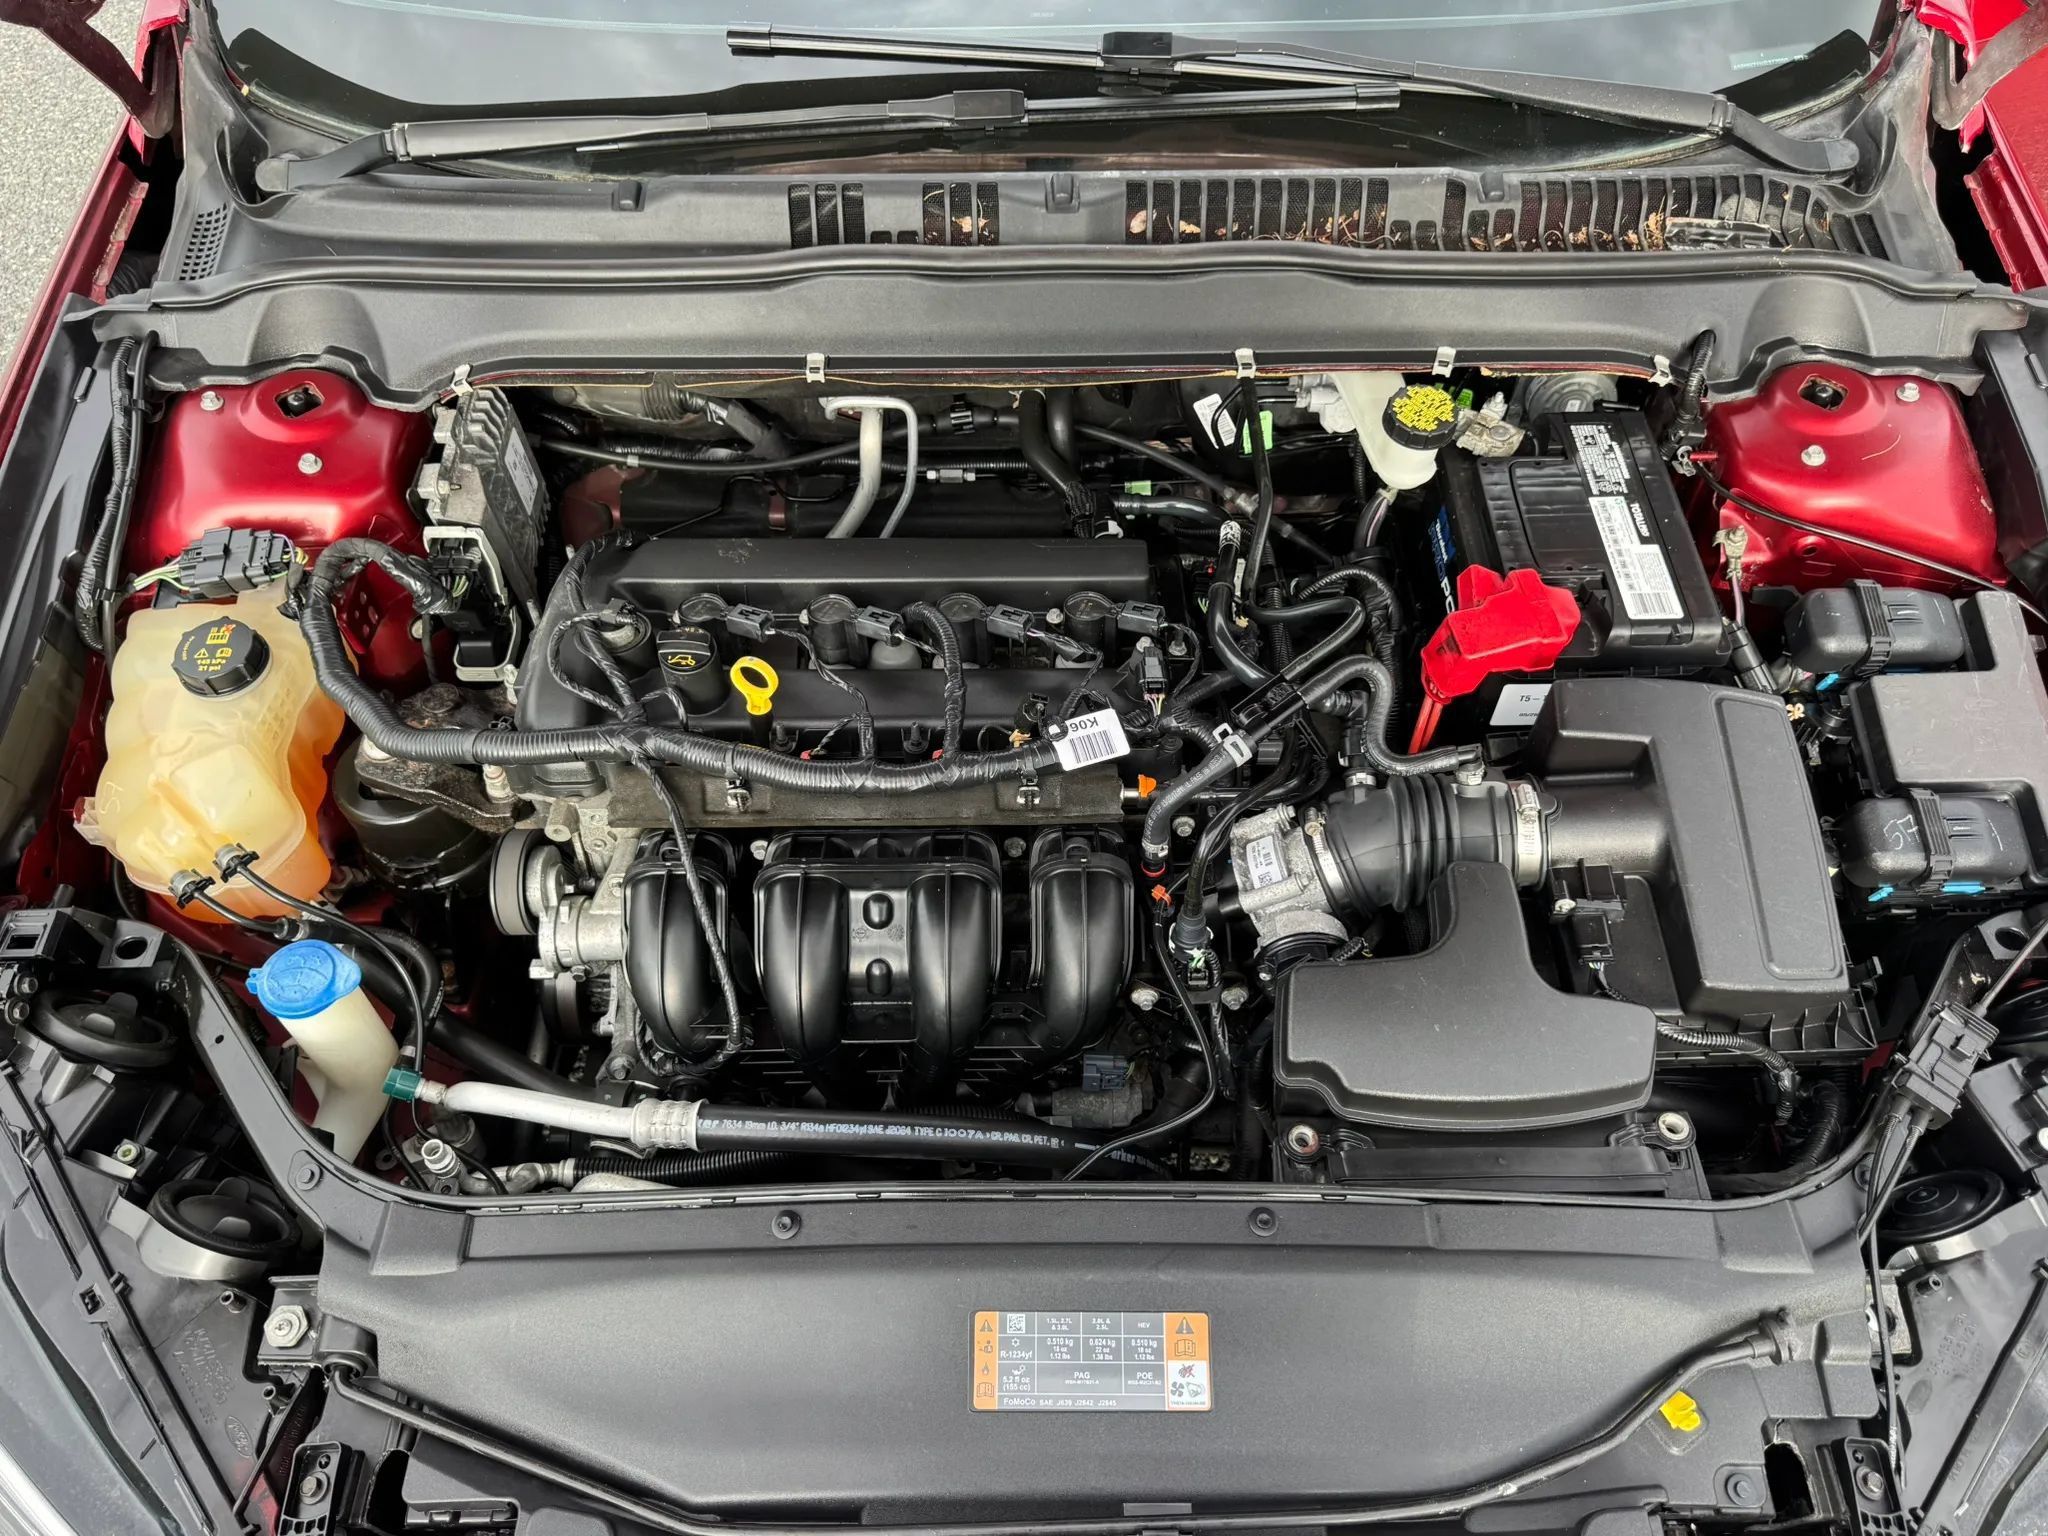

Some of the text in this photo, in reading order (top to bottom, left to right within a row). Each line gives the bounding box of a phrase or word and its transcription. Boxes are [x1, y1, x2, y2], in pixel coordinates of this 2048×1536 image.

[1435, 518, 1448, 563] Duralast
[208, 664, 221, 672] psi
[1519, 694, 1532, 702] T5
[1070, 717, 1099, 733] K06
[867, 1124, 884, 1134] SAE
[914, 1126, 934, 1137] TYPE
[1046, 1338, 1073, 1347] 0.510 kg
[1089, 1338, 1116, 1347] 0.624 kg
[1131, 1338, 1158, 1347] 0.510 kg
[1000, 1350, 1033, 1359] R-1234yf
[1074, 1371, 1090, 1379] PAG
[1136, 1371, 1153, 1380] POE
[1003, 1383, 1031, 1392] (155 cc)
[1003, 1397, 1036, 1406] FoMoCo
[1056, 1399, 1072, 1407] J639
